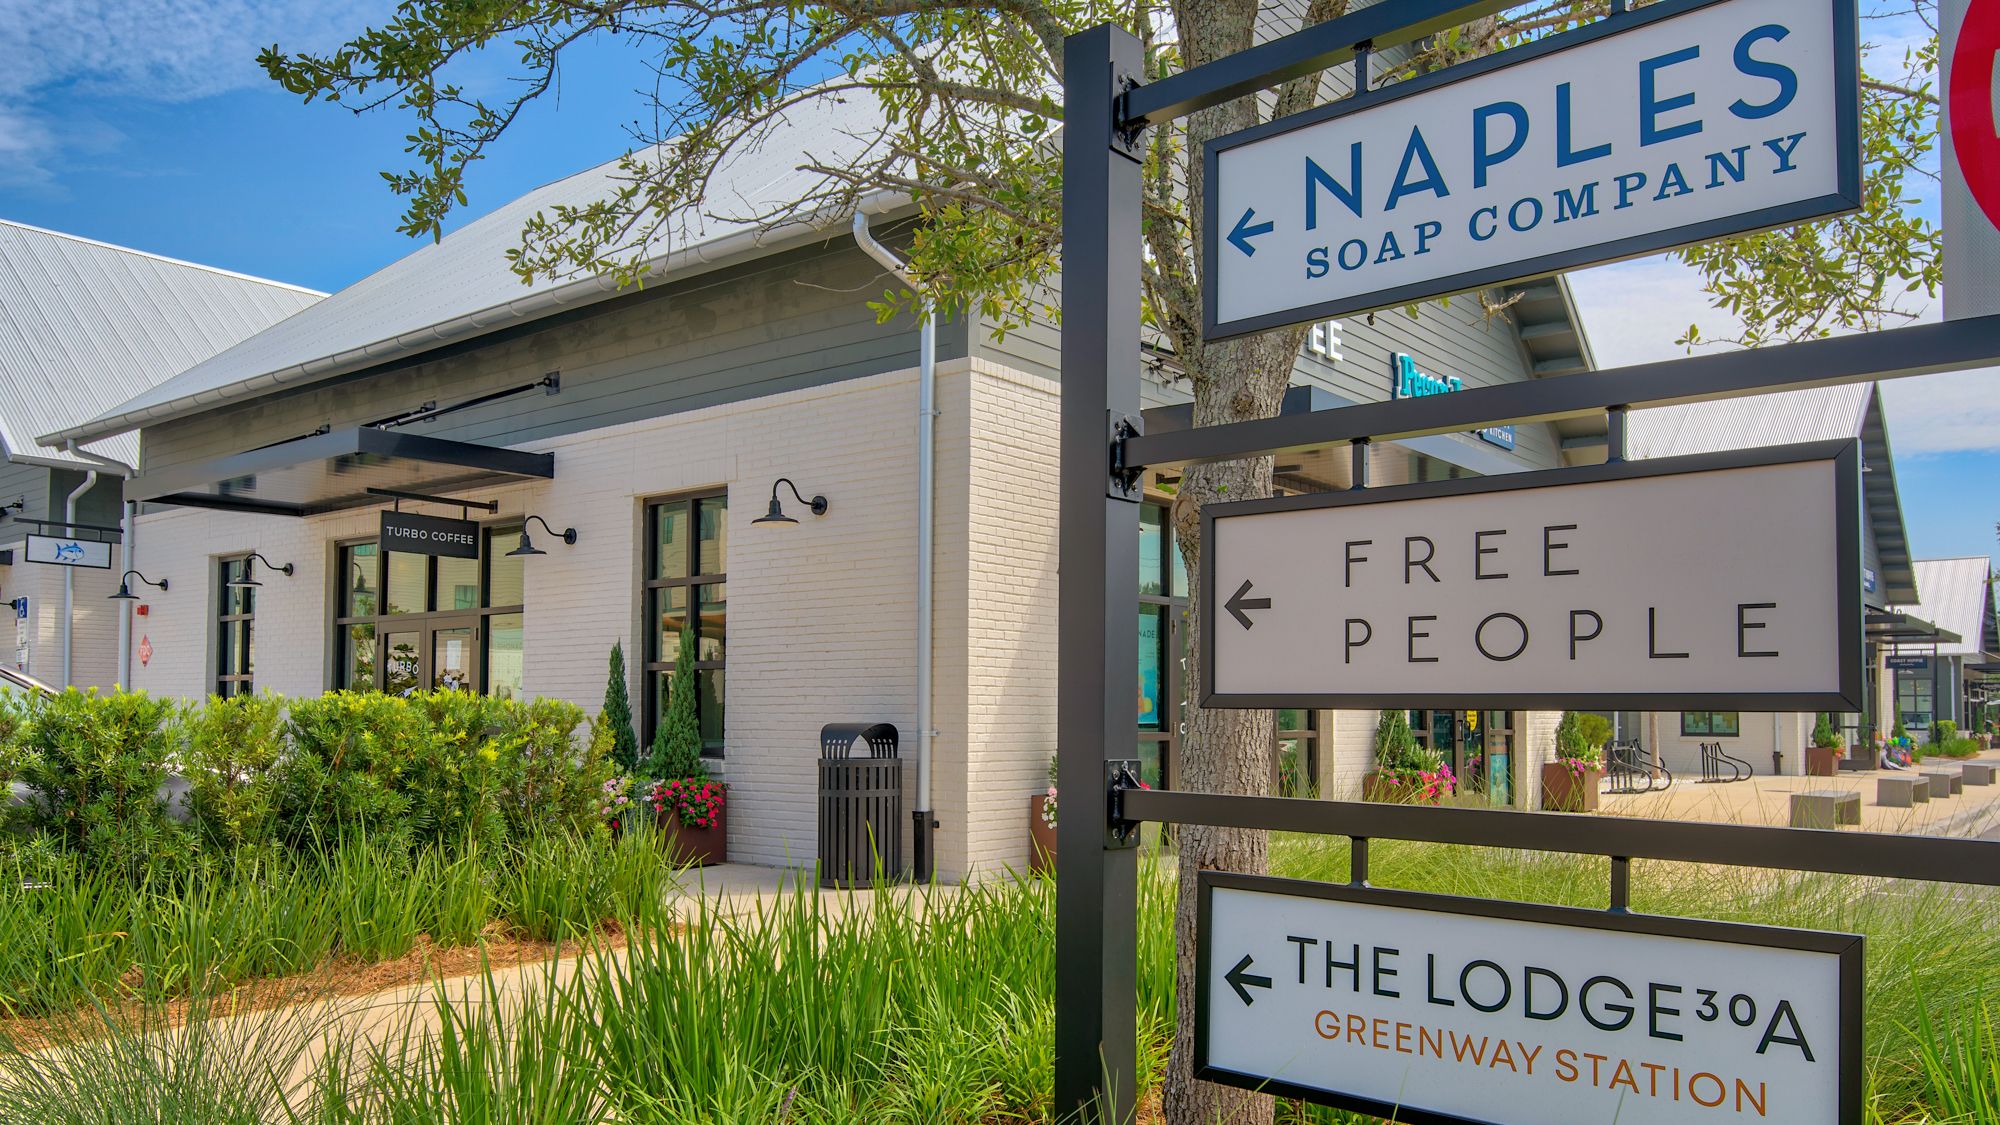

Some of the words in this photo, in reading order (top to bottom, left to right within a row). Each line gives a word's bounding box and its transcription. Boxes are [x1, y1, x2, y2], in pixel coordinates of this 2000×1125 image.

[1305, 24, 1799, 231] NAPLES
[1306, 220, 1443, 280] SOAP
[1469, 132, 1807, 241] COMPANY
[386, 526, 428, 540] TURBO
[431, 531, 474, 545] COFFEE
[1345, 524, 1580, 588] FREE
[1345, 602, 1780, 665] PEOPLE
[387, 660, 419, 675] URBO
[1286, 935, 1401, 998] THE
[1314, 1009, 1543, 1075] GREENWAY
[1554, 1048, 1767, 1117] STATION
